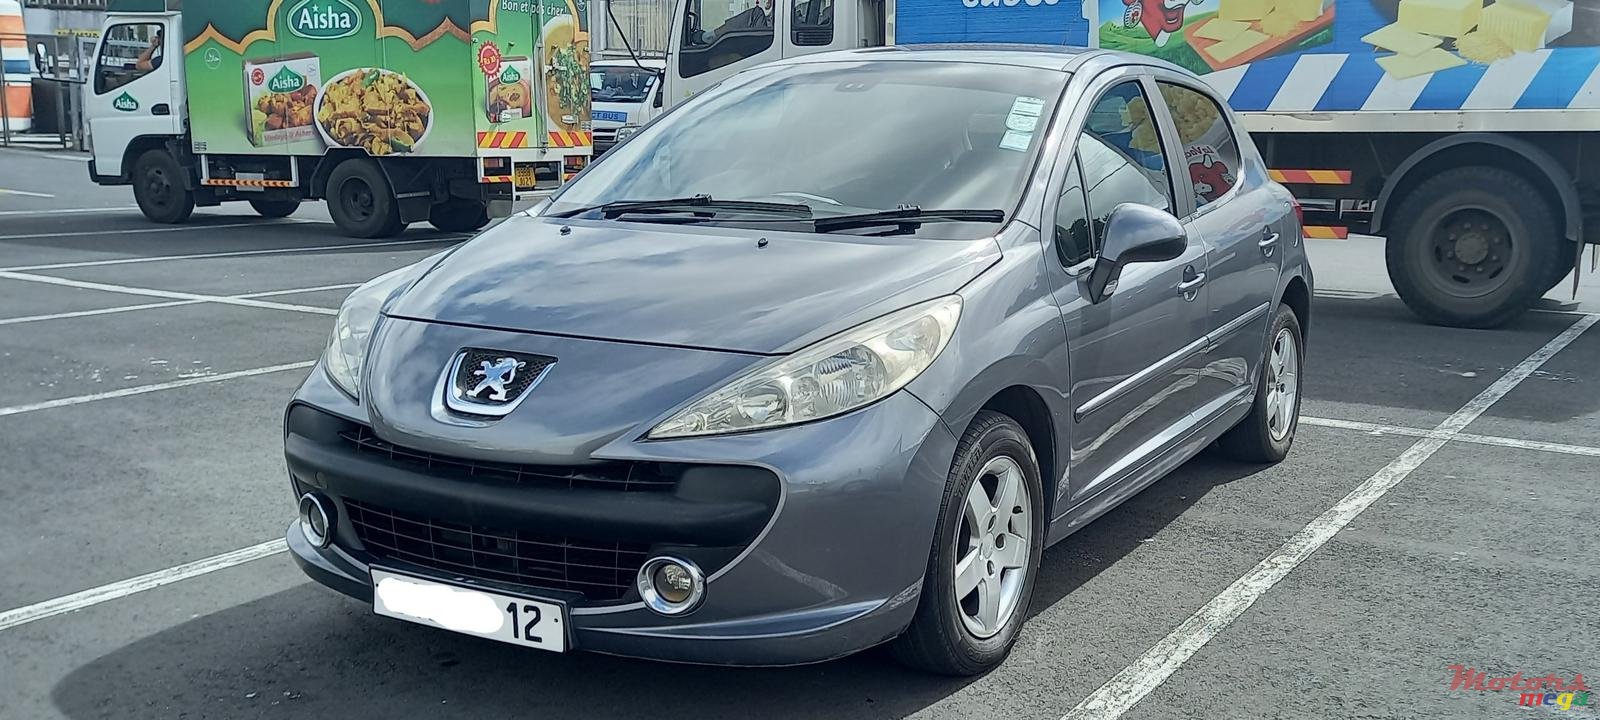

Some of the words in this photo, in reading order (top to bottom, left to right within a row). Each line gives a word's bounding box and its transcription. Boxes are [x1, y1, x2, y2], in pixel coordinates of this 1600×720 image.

[502, 0, 518, 11] Bon
[520, 2, 528, 13] et
[298, 4, 351, 29] Aisha
[271, 75, 300, 90] Aisha
[115, 97, 137, 110] Aisha
[603, 112, 619, 120] BUS
[506, 602, 543, 643] 12
